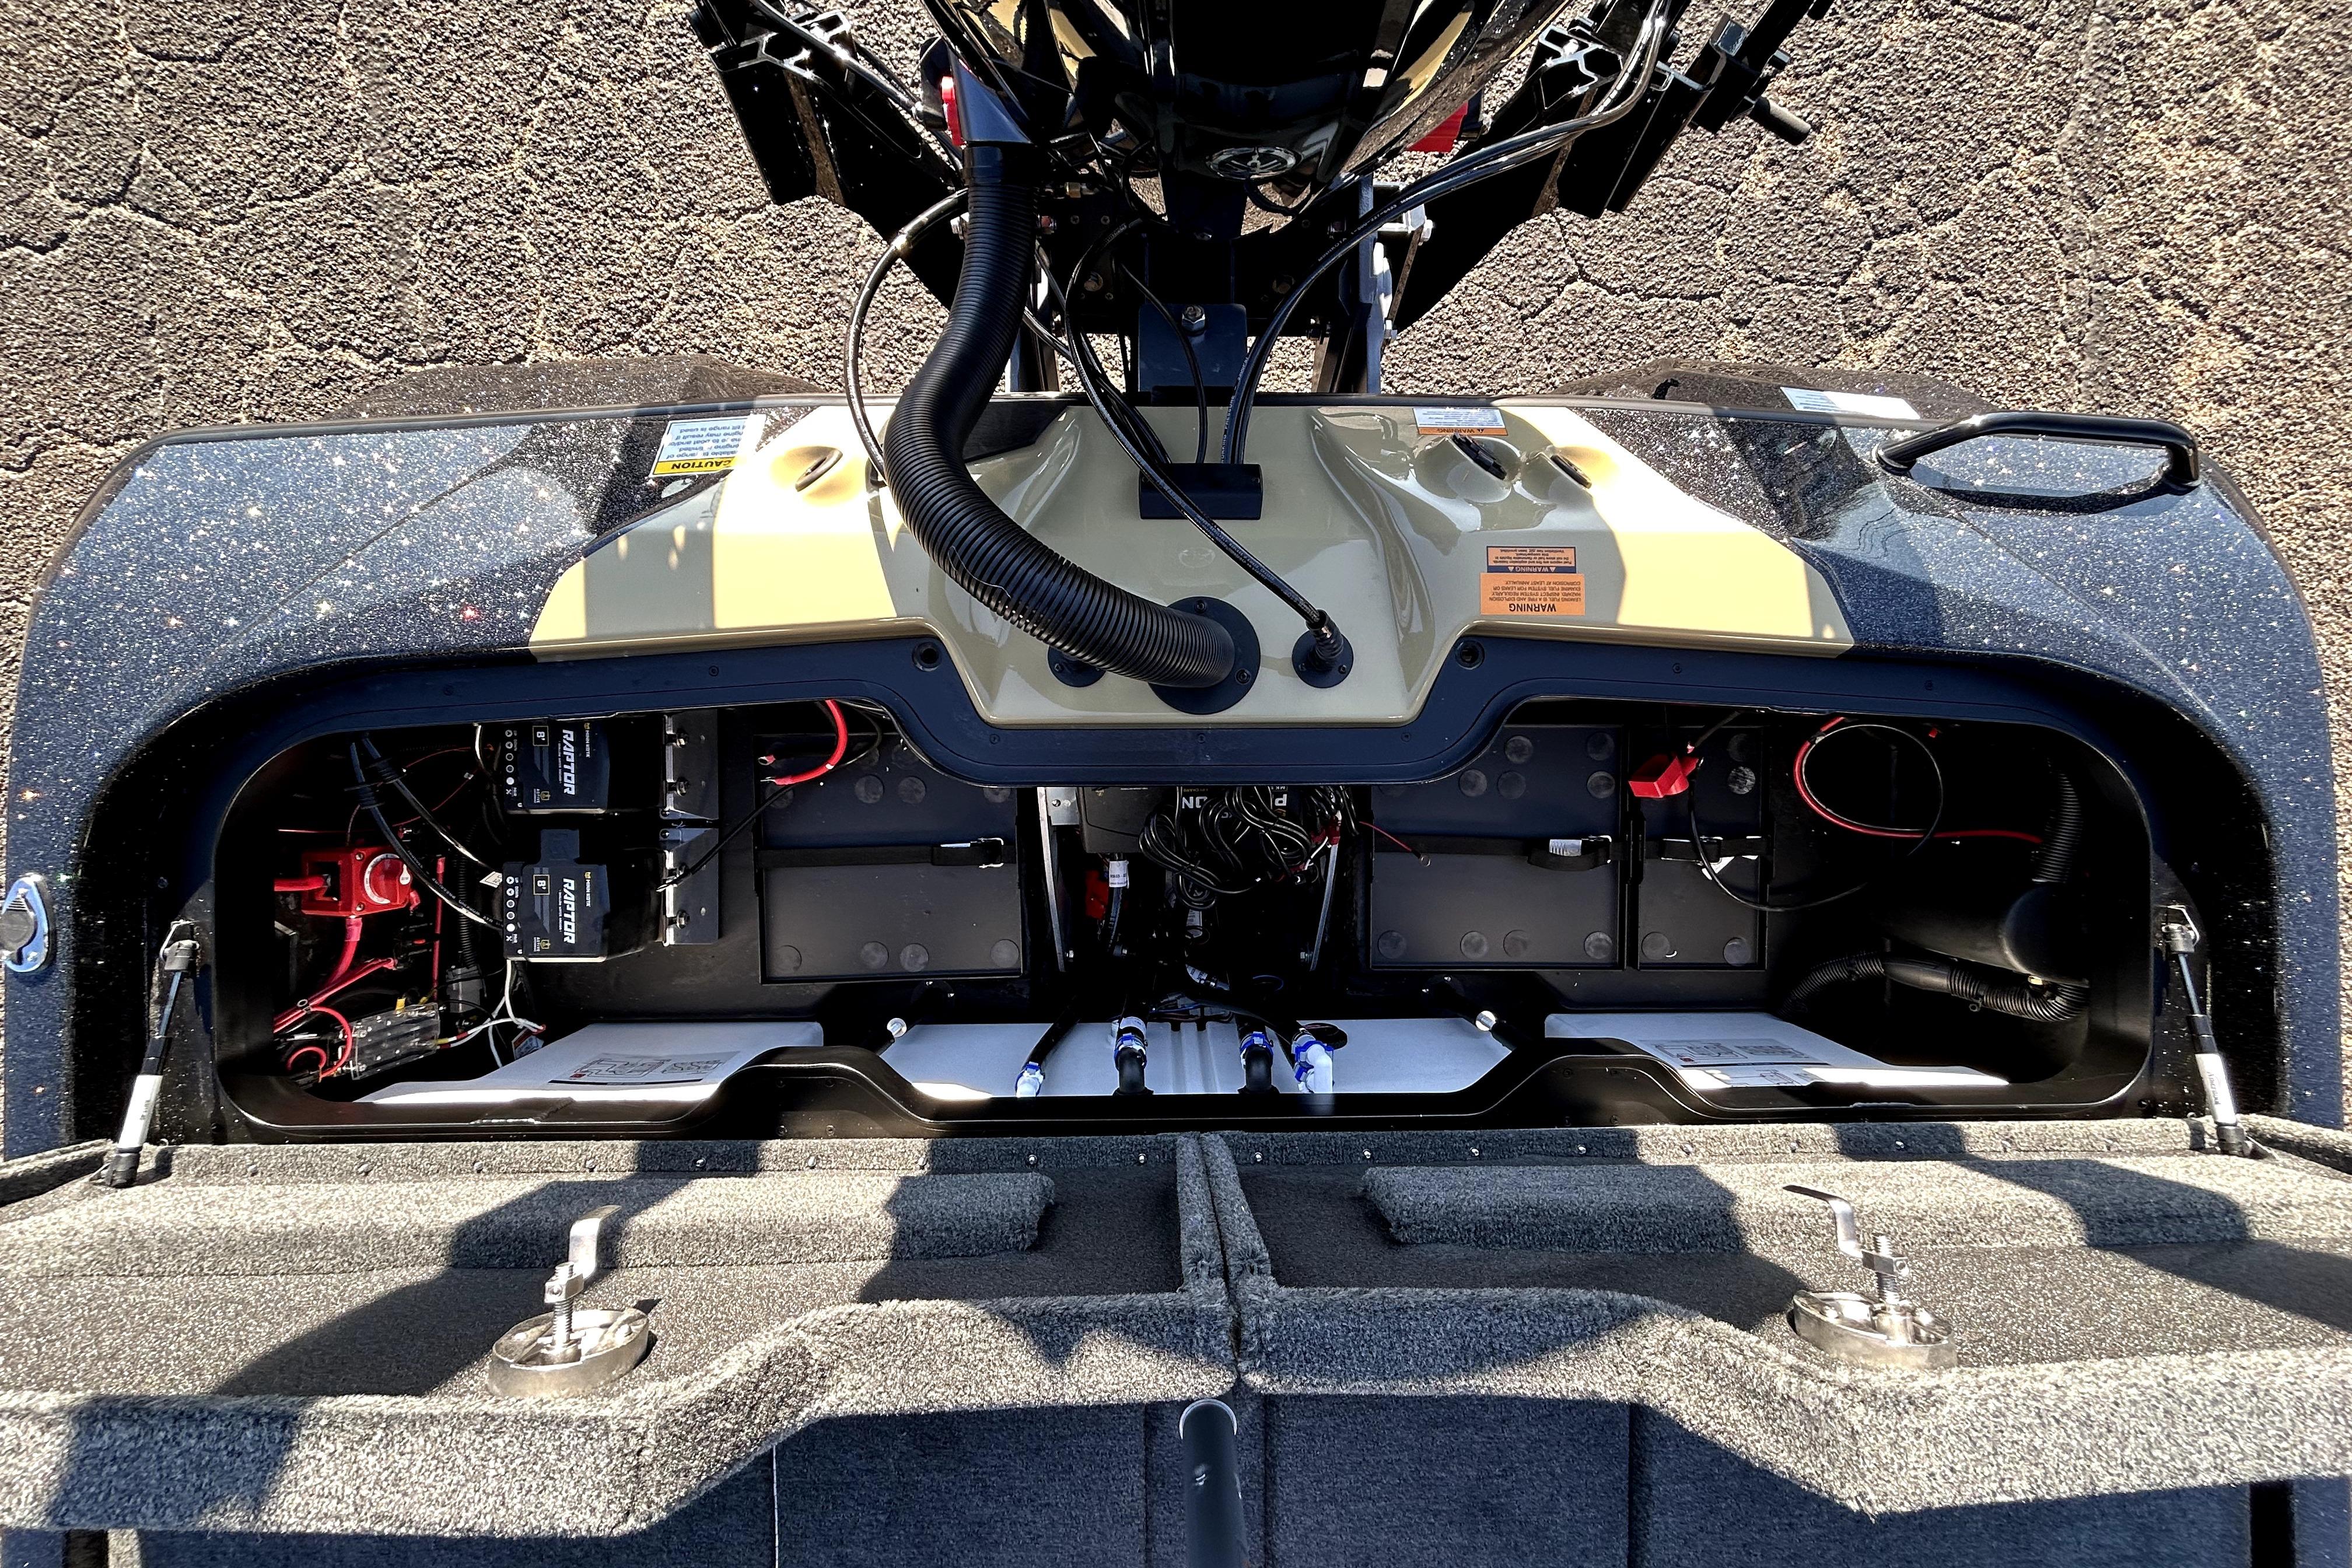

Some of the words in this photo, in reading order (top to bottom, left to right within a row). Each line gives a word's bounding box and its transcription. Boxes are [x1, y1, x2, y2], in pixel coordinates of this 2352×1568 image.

[671, 460, 731, 470] CAUTION
[1508, 603, 1556, 612] WARNING
[562, 730, 575, 795] RAPTOR
[563, 878, 575, 944] RAPTOR
